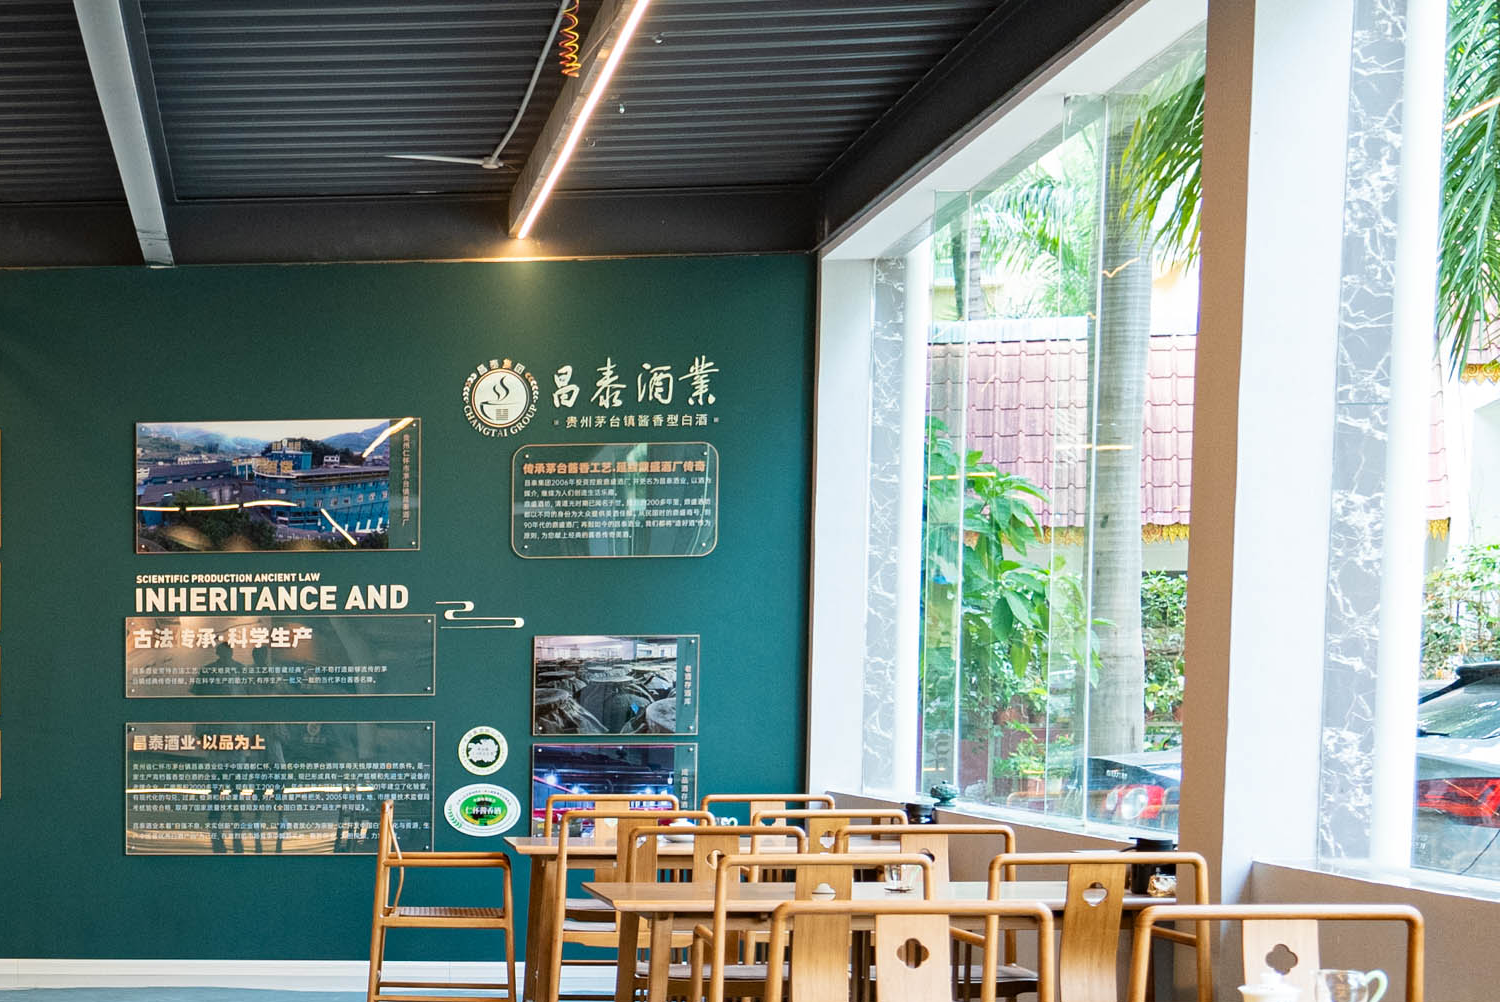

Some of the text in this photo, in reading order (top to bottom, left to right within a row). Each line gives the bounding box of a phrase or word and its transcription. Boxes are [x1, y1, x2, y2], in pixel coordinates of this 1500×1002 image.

[552, 355, 720, 409] 昌泰酒業
[463, 404, 538, 437] CHANGTAI GROUP
[565, 413, 709, 429] 贵州茅台镇酱香型白酒
[136, 572, 321, 584] SCIENTIFIC PRODUCTION ANCIENT LAW
[135, 584, 409, 613] INHERITANCE AND
[133, 734, 266, 751] 昌泰酒业·以品为上
